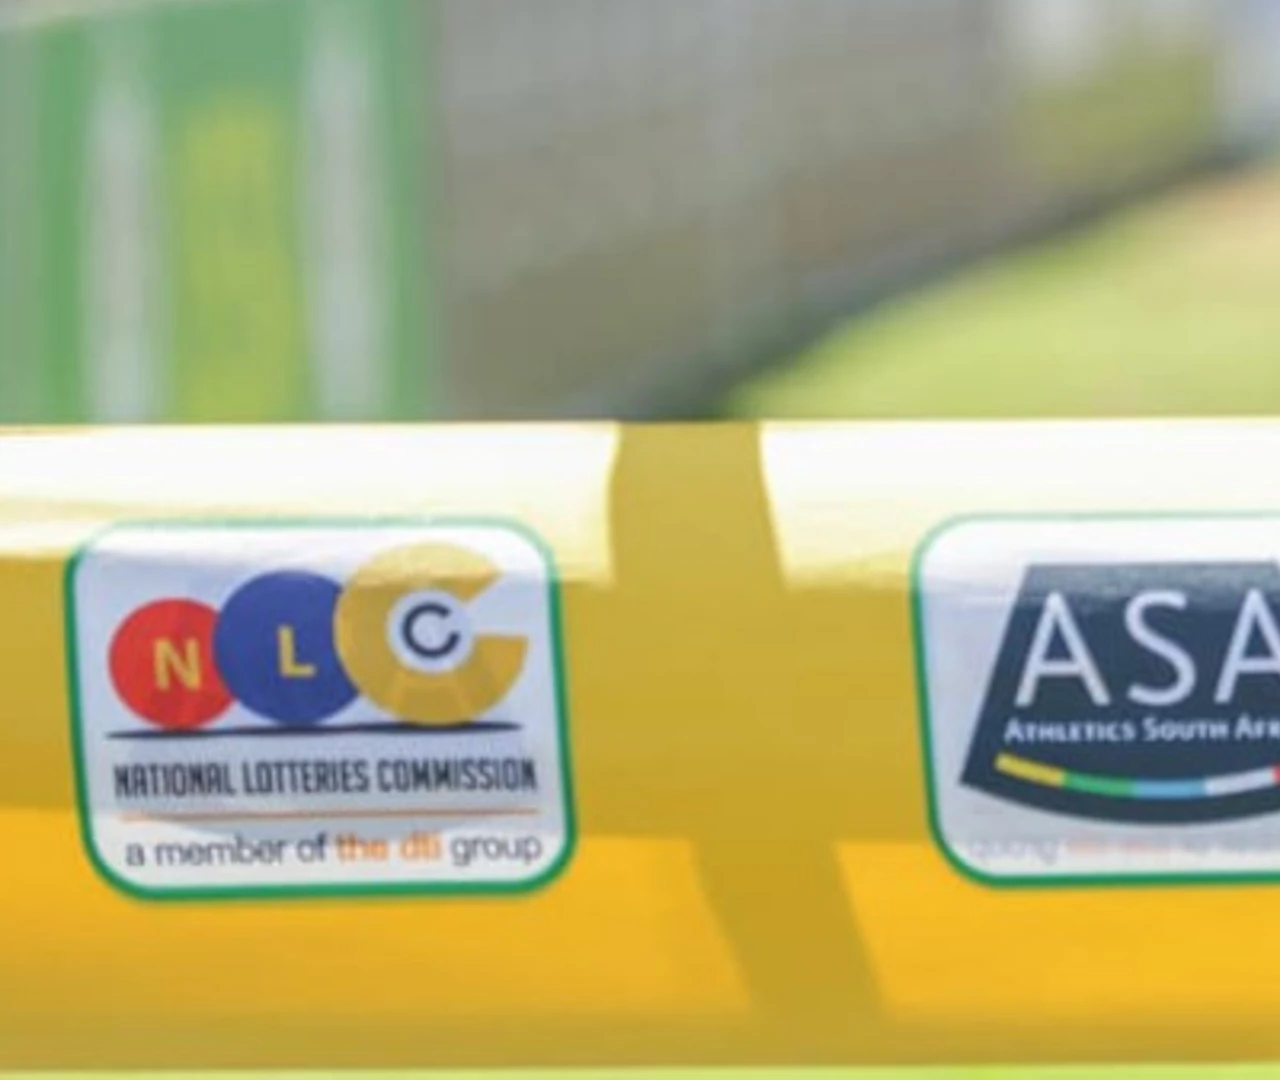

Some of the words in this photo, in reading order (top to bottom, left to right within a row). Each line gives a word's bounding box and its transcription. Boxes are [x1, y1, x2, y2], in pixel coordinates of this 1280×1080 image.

[114, 761, 236, 799] NATIONAL
[243, 760, 369, 795] LOTTERIES
[377, 758, 538, 791] COMMISSION
[126, 843, 145, 867] a
[155, 833, 288, 866] member
[296, 830, 329, 863] of
[335, 831, 387, 861] the
[449, 833, 542, 866] group
